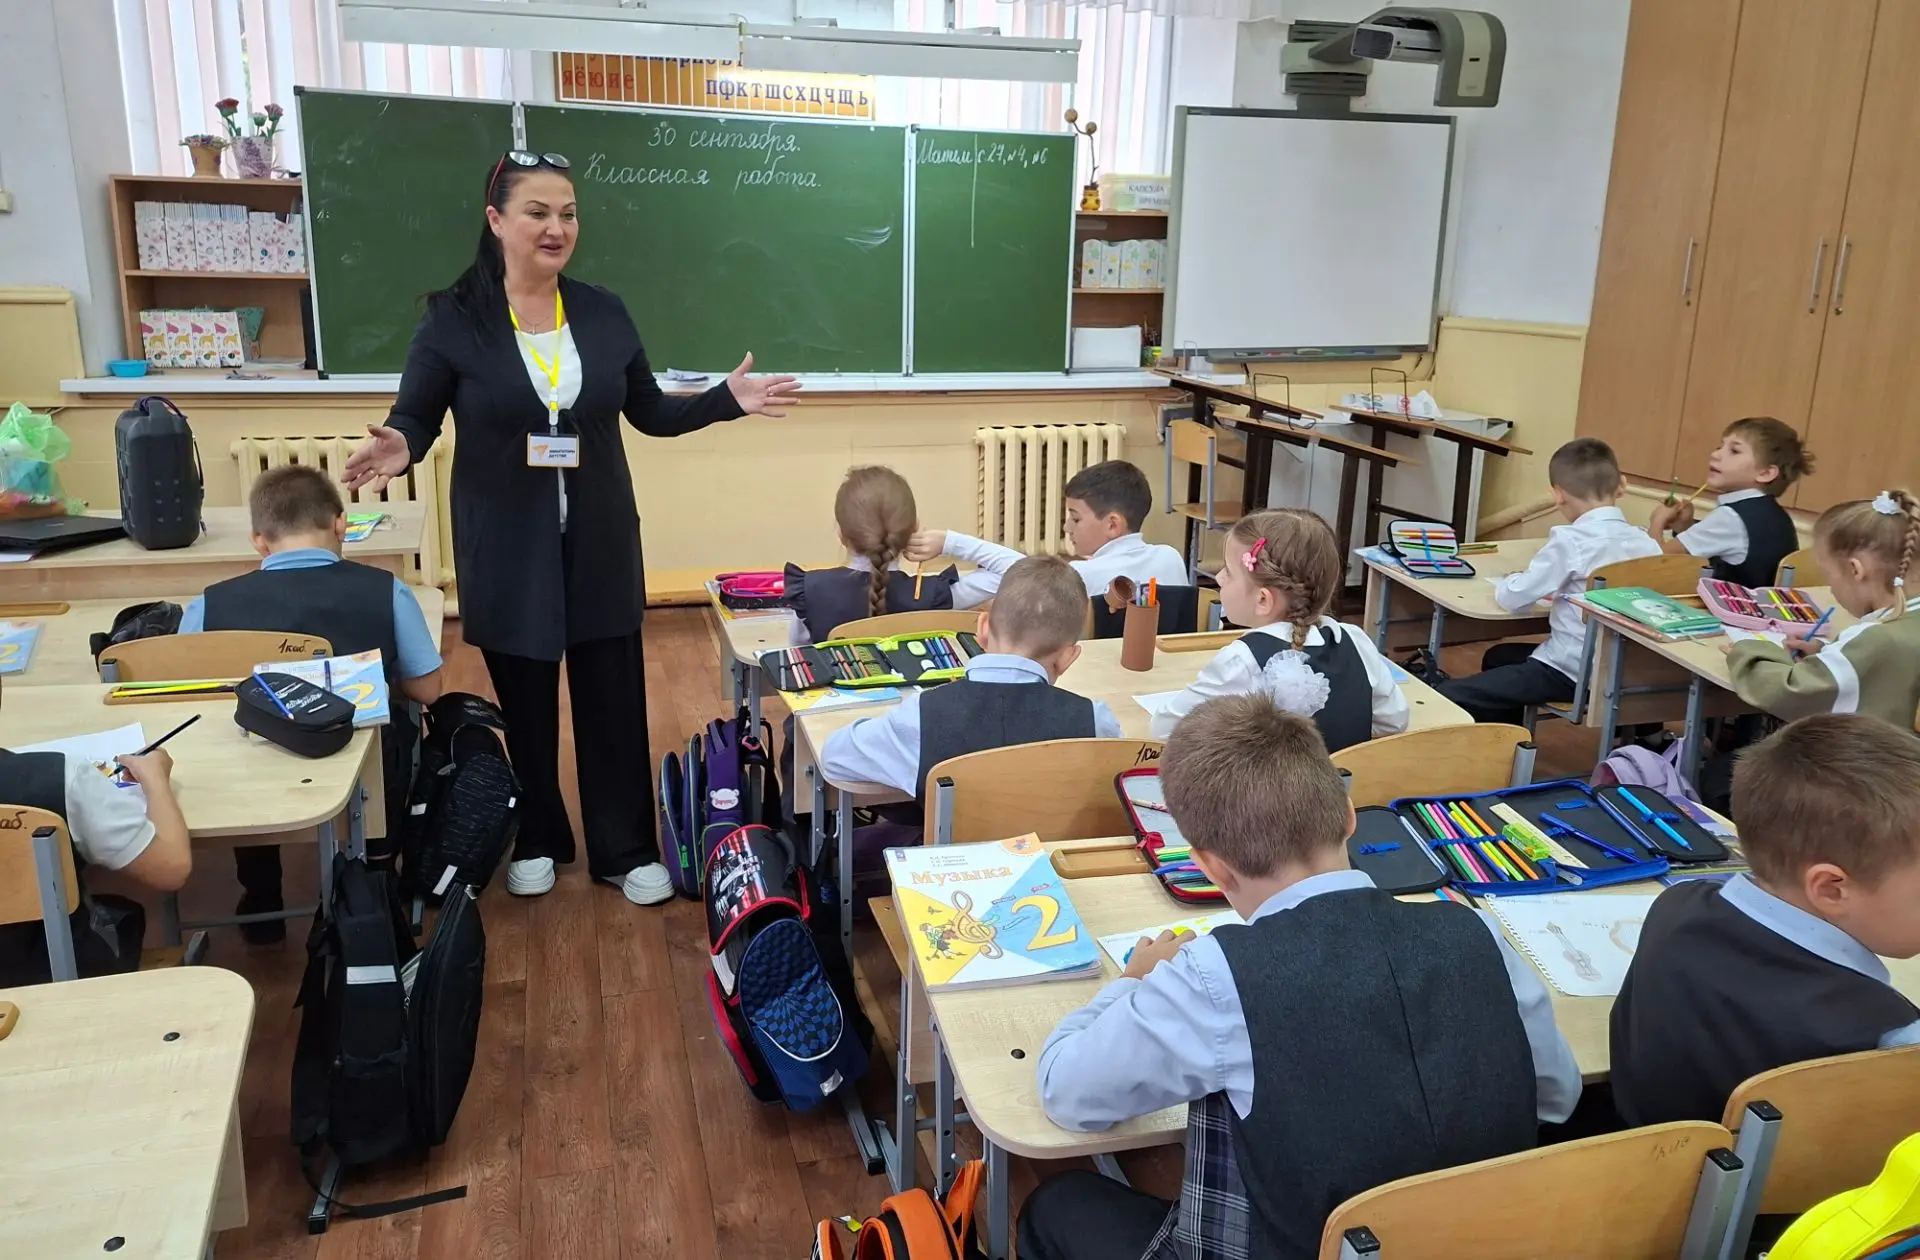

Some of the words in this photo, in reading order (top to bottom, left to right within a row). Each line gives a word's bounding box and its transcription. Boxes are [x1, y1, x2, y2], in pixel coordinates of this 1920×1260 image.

[648, 127, 677, 147] 30
[584, 152, 710, 185] Классная
[910, 867, 1013, 886] Музыка
[1011, 893, 1078, 952] 2
